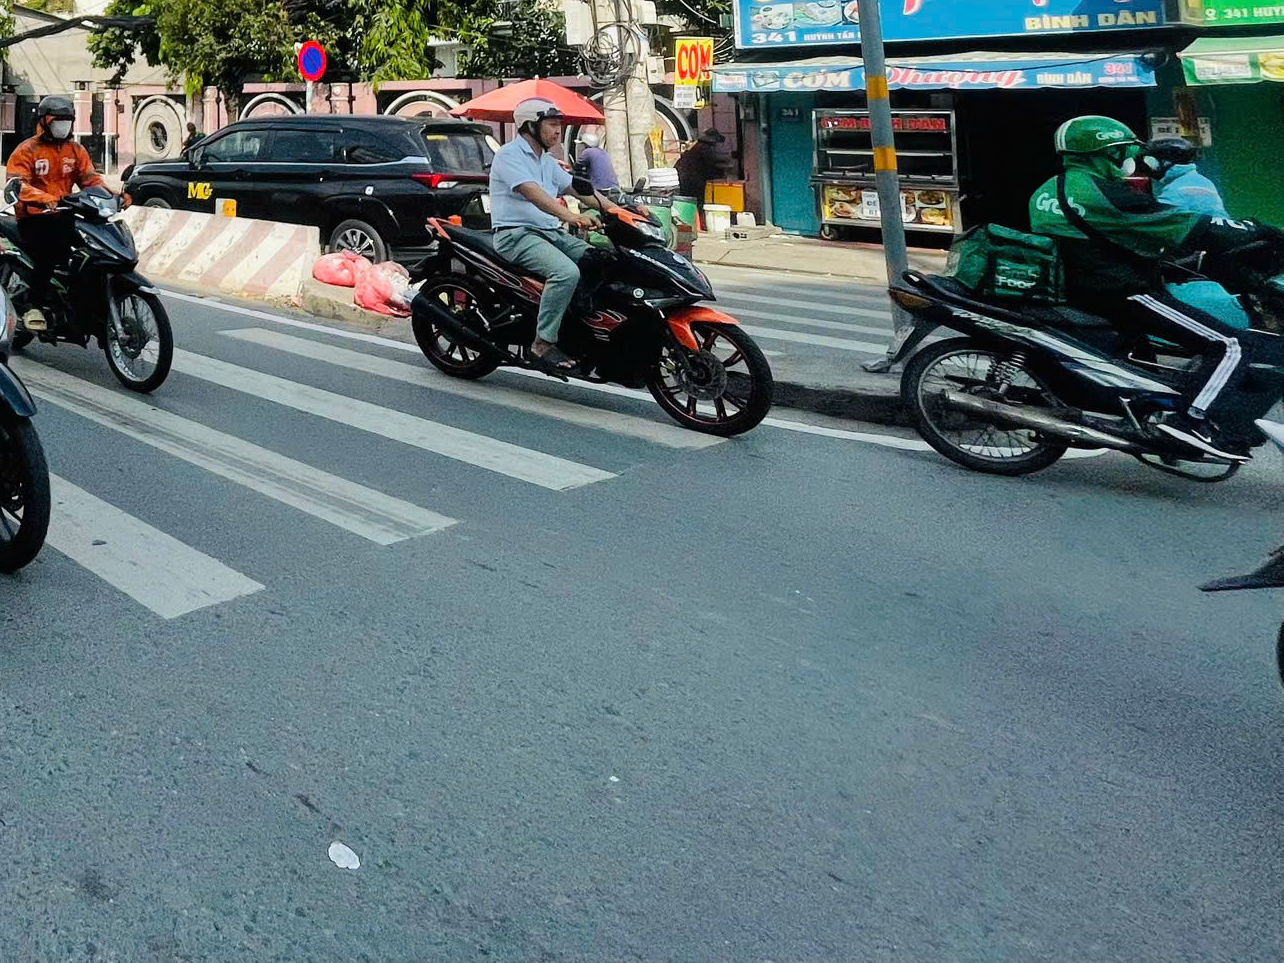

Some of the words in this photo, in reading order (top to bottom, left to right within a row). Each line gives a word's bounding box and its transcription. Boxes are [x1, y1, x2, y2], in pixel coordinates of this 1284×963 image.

[1024, 13, 1089, 30] BÌNH
[1098, 10, 1157, 27] DÂN
[751, 30, 797, 44] 341
[783, 68, 851, 88] CƠM
[1096, 129, 1124, 141] Grab
